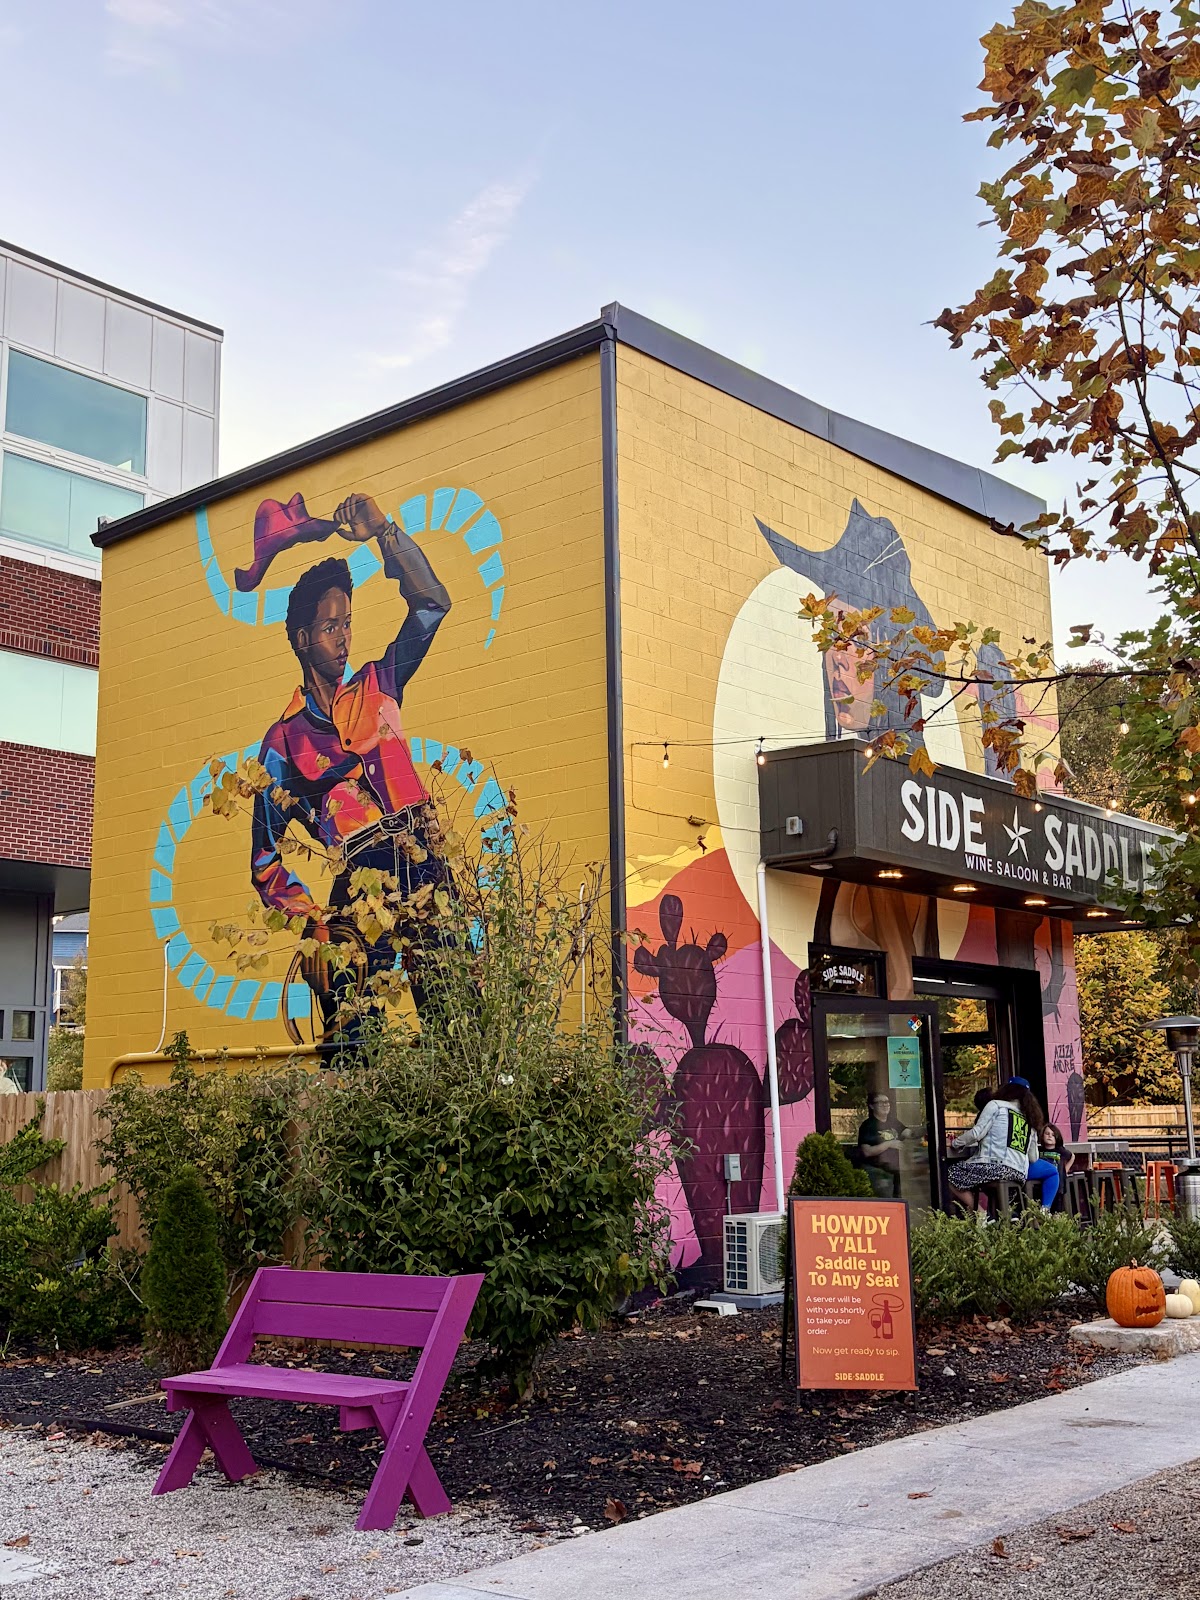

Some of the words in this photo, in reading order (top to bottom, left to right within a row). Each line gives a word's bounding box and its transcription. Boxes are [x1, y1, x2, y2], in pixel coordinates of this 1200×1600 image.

[900, 779, 987, 857] SIDE
[965, 853, 993, 874] WINE
[997, 860, 1039, 883] SALOON
[1043, 870, 1049, 885] &
[1052, 872, 1072, 890] BAR
[823, 966, 838, 981] SIDE
[839, 965, 864, 984] SADDLE
[811, 1214, 890, 1235] HOWDY
[827, 1236, 877, 1254] Y'ALL
[815, 1256, 866, 1271] Saddle
[872, 1259, 891, 1274] up
[808, 1272, 827, 1286] To
[832, 1273, 861, 1289] Any
[866, 1273, 899, 1287] Seat
[824, 1308, 838, 1316] you
[840, 1307, 865, 1315] shortly
[834, 1318, 851, 1326] your
[834, 1348, 848, 1356] get
[850, 1348, 874, 1356] ready
[886, 1348, 899, 1357] sip.
